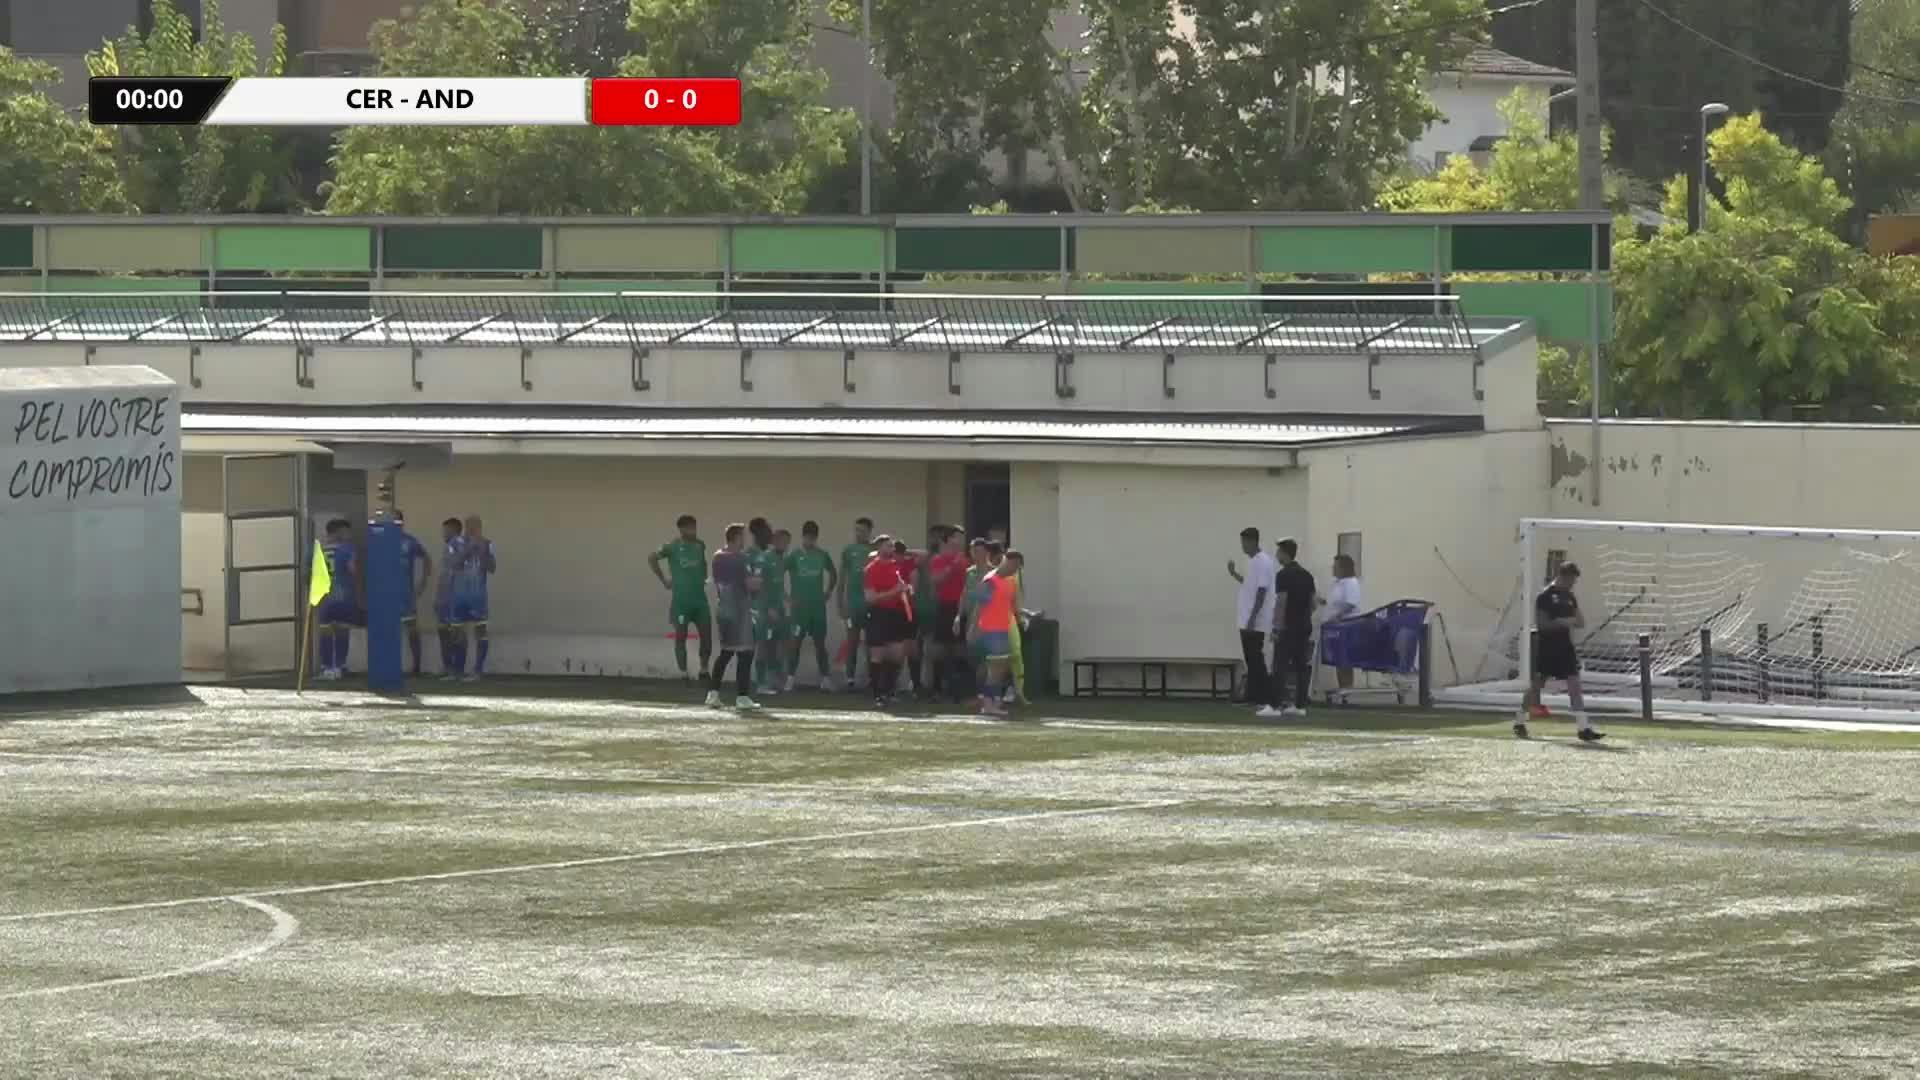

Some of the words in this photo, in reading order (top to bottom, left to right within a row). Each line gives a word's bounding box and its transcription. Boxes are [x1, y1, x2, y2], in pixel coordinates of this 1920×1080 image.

[15, 401, 68, 444] PEL
[77, 397, 168, 438] VOSTRE
[9, 442, 174, 500] COMPROMÍS
